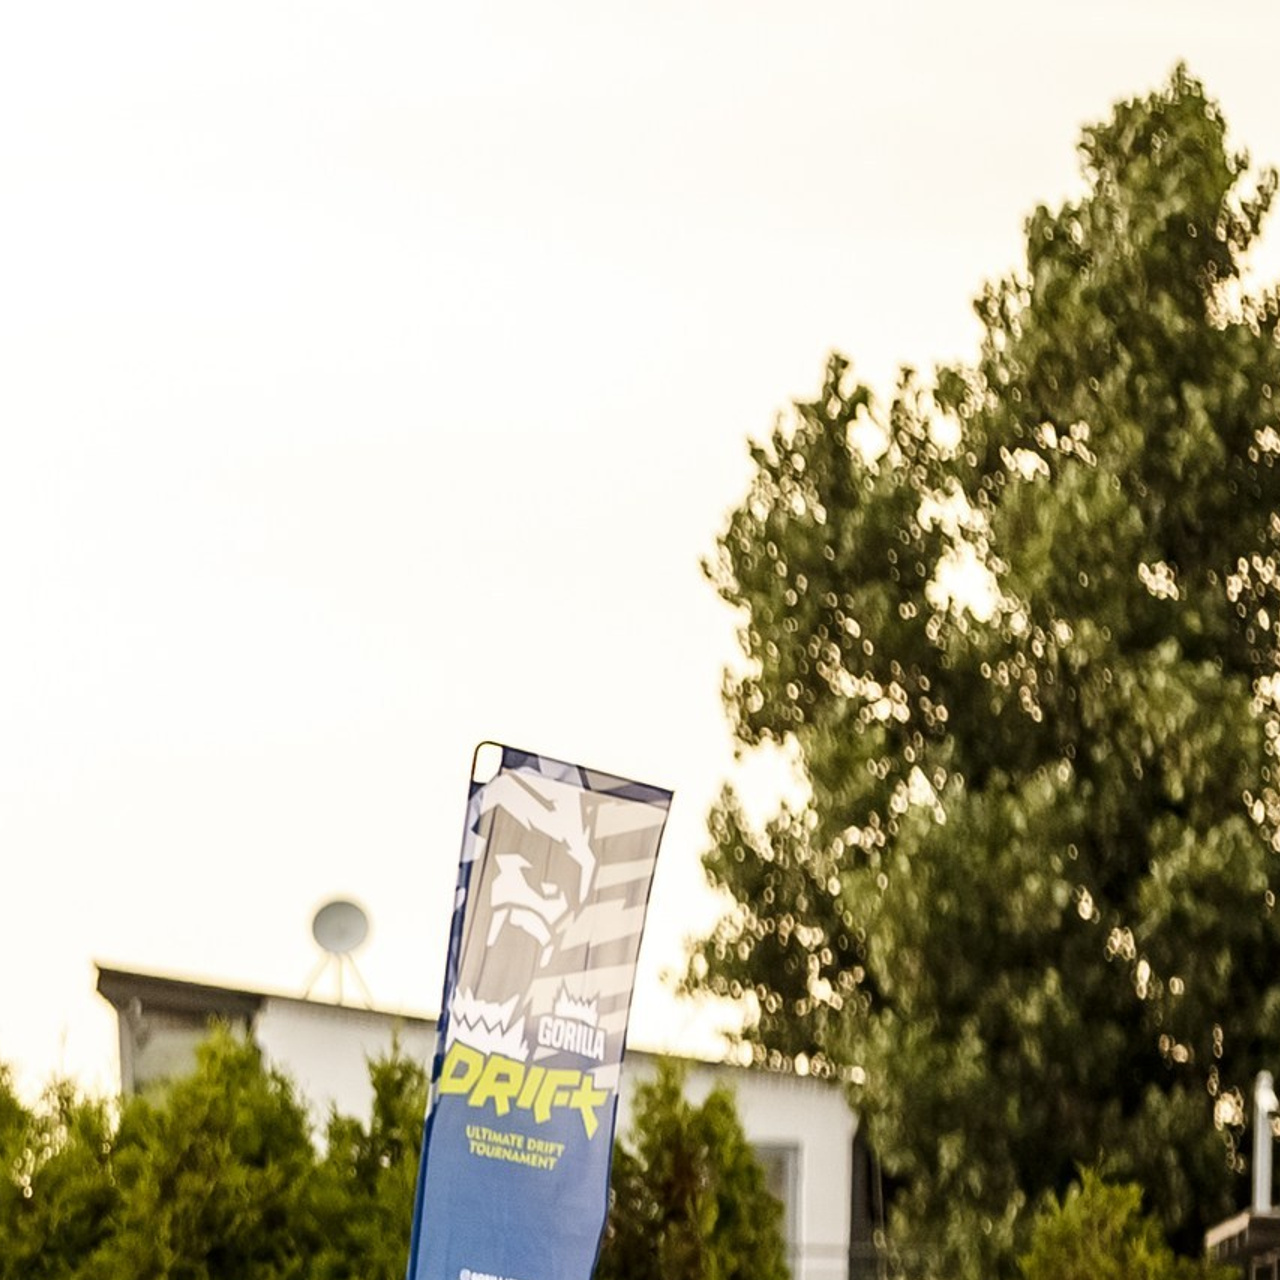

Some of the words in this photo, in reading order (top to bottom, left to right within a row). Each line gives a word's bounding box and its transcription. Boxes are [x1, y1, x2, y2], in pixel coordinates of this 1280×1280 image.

[538, 1015, 606, 1061] GORILLA
[438, 1039, 609, 1140] DRIFT
[466, 1125, 524, 1149] ULTIMATE
[527, 1137, 565, 1158] DRIFT
[470, 1140, 557, 1171] TOURNAMENT
